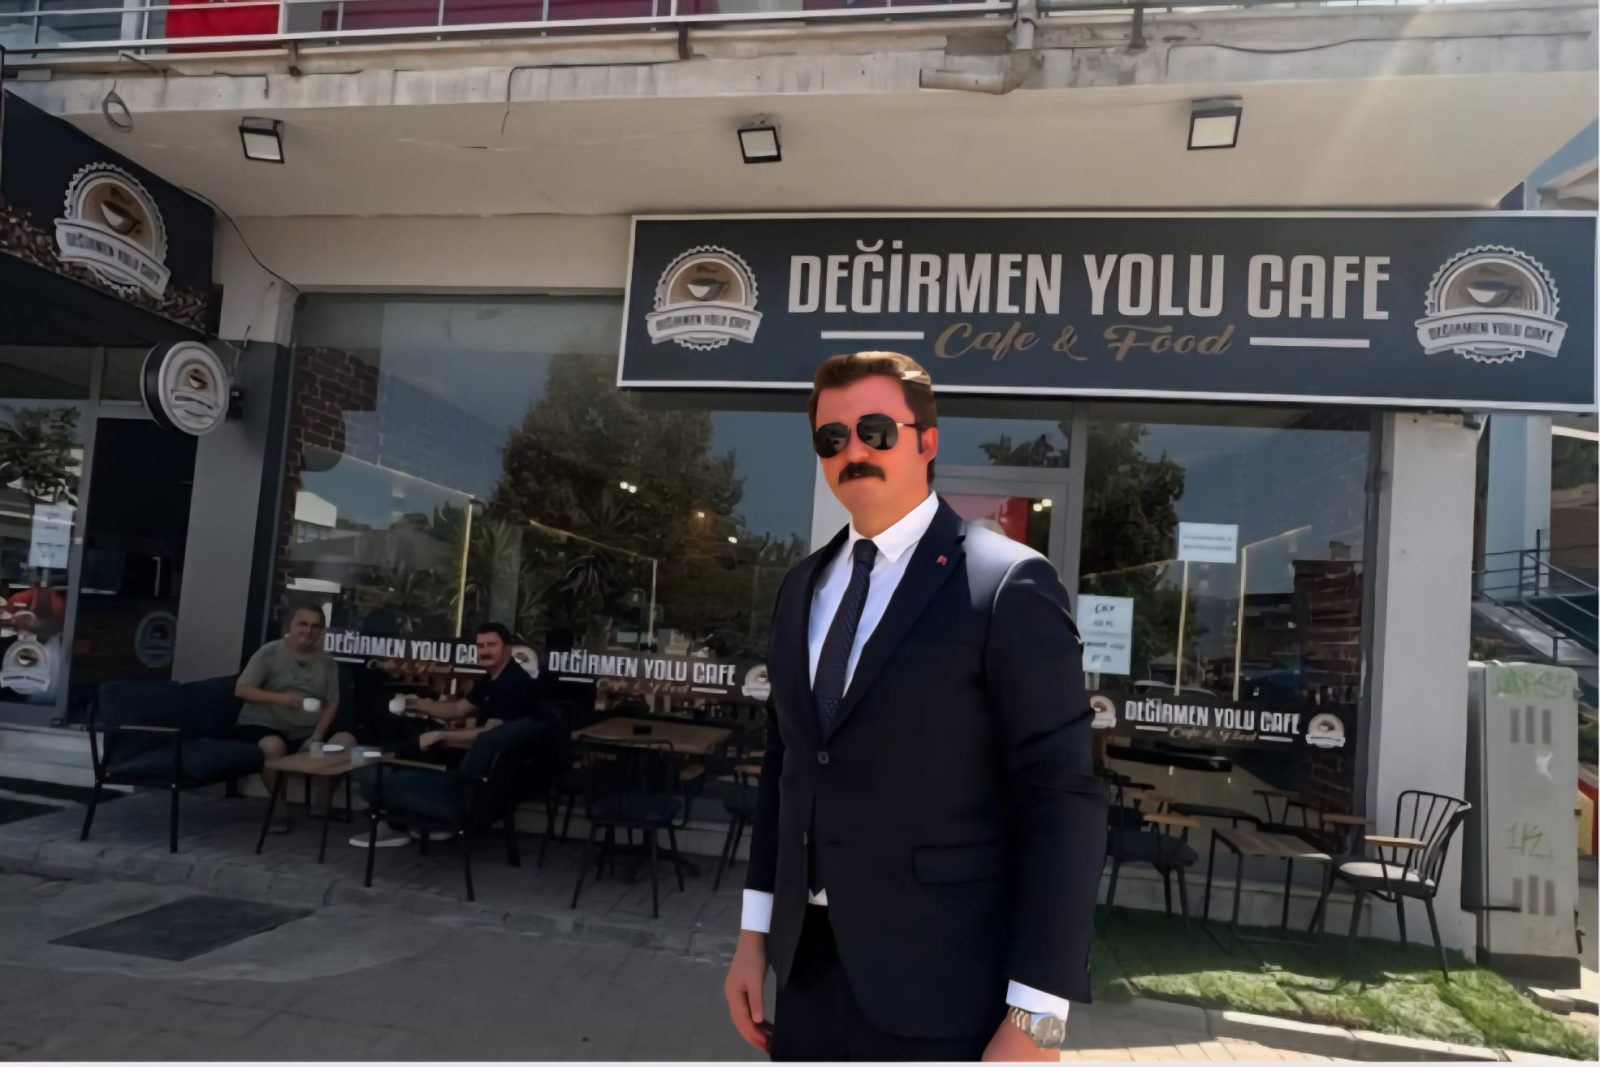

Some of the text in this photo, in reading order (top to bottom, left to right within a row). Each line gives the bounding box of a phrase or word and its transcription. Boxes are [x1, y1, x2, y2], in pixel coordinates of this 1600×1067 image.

[788, 239, 1391, 320] DEĞİRMEN YOLU CAFE
[934, 321, 1235, 361] Cafe & Food
[411, 640, 451, 662] YOLU
[455, 643, 478, 665] CA
[644, 659, 687, 682] YOLU
[693, 662, 735, 685] CAFE
[1215, 708, 1255, 731] YOLU
[1260, 711, 1300, 735] CAFE
